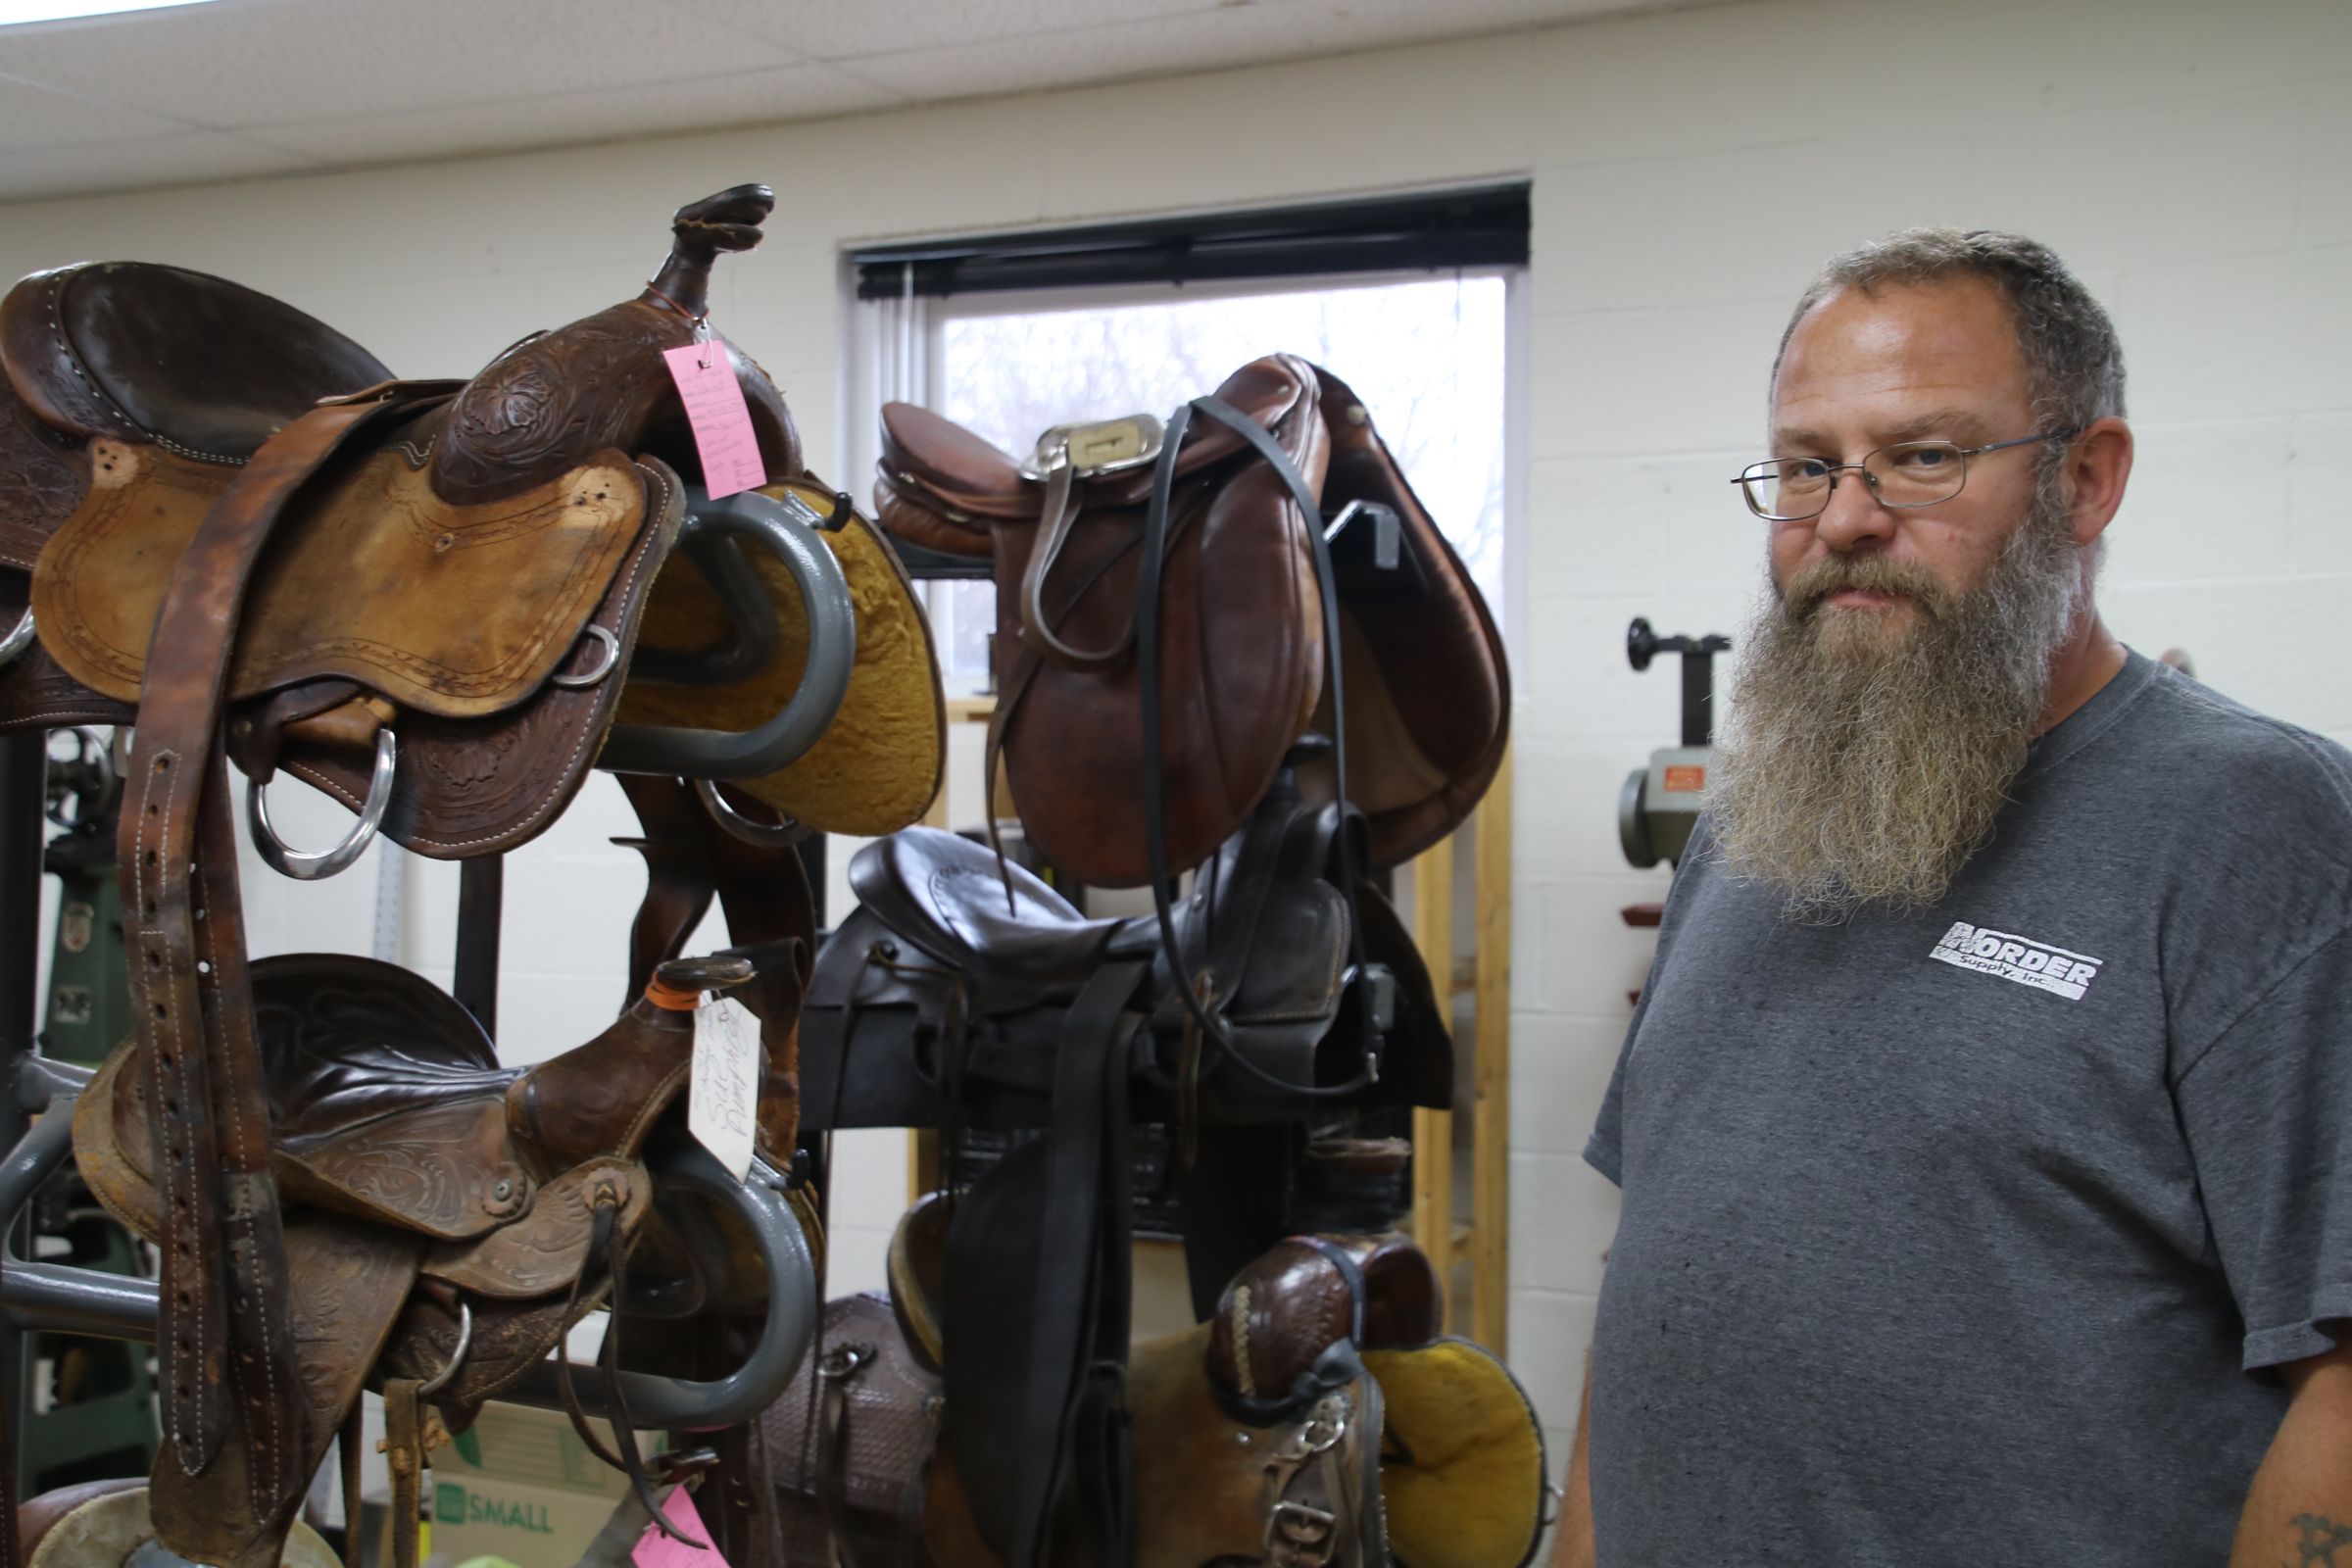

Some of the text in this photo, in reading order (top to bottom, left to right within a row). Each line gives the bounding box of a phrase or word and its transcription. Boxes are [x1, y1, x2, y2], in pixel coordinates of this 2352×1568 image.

[1938, 921, 2097, 987] NORDER
[1960, 954, 2015, 977] Supply,
[468, 1494, 556, 1535] SMALL
